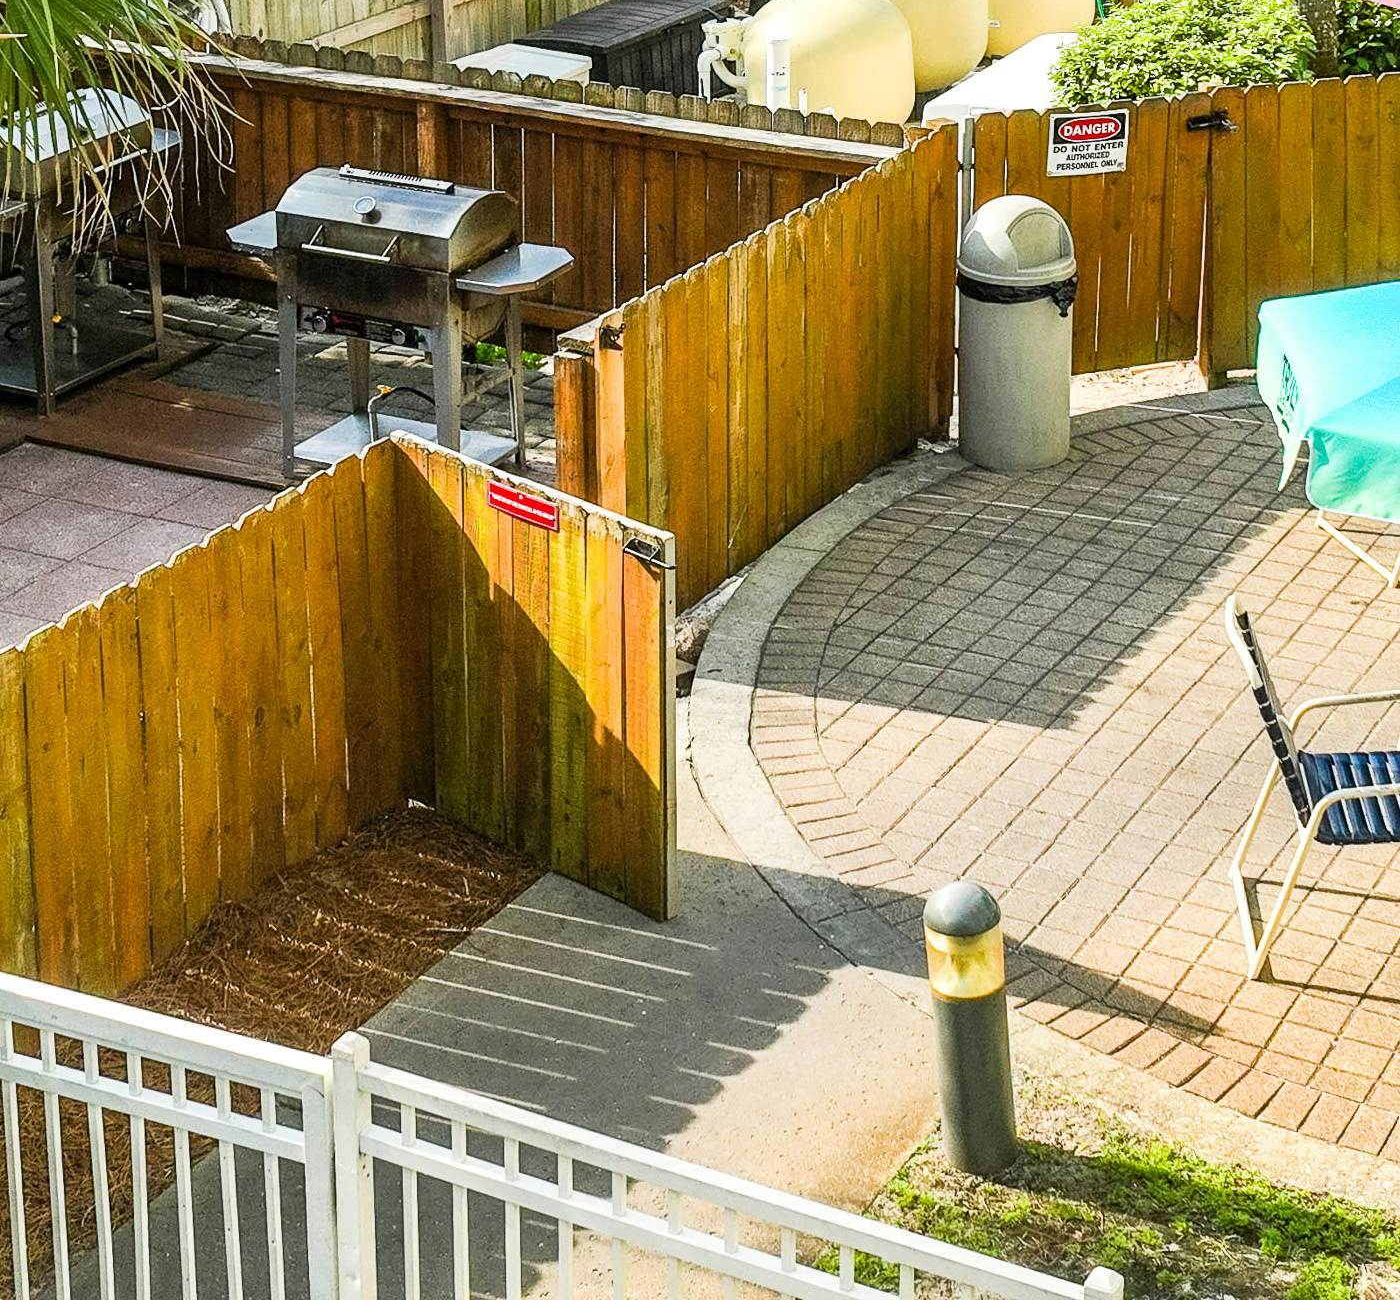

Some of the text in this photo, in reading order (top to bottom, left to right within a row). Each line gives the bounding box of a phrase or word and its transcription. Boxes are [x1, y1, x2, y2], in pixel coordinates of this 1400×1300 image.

[1064, 122, 1115, 136] DANGER
[1071, 144, 1091, 152] NOT
[1094, 141, 1124, 151] ENTER
[1066, 151, 1110, 161] AUTHORIZED
[1056, 161, 1098, 170] PERSONNEL
[1101, 159, 1117, 167] ONLY
